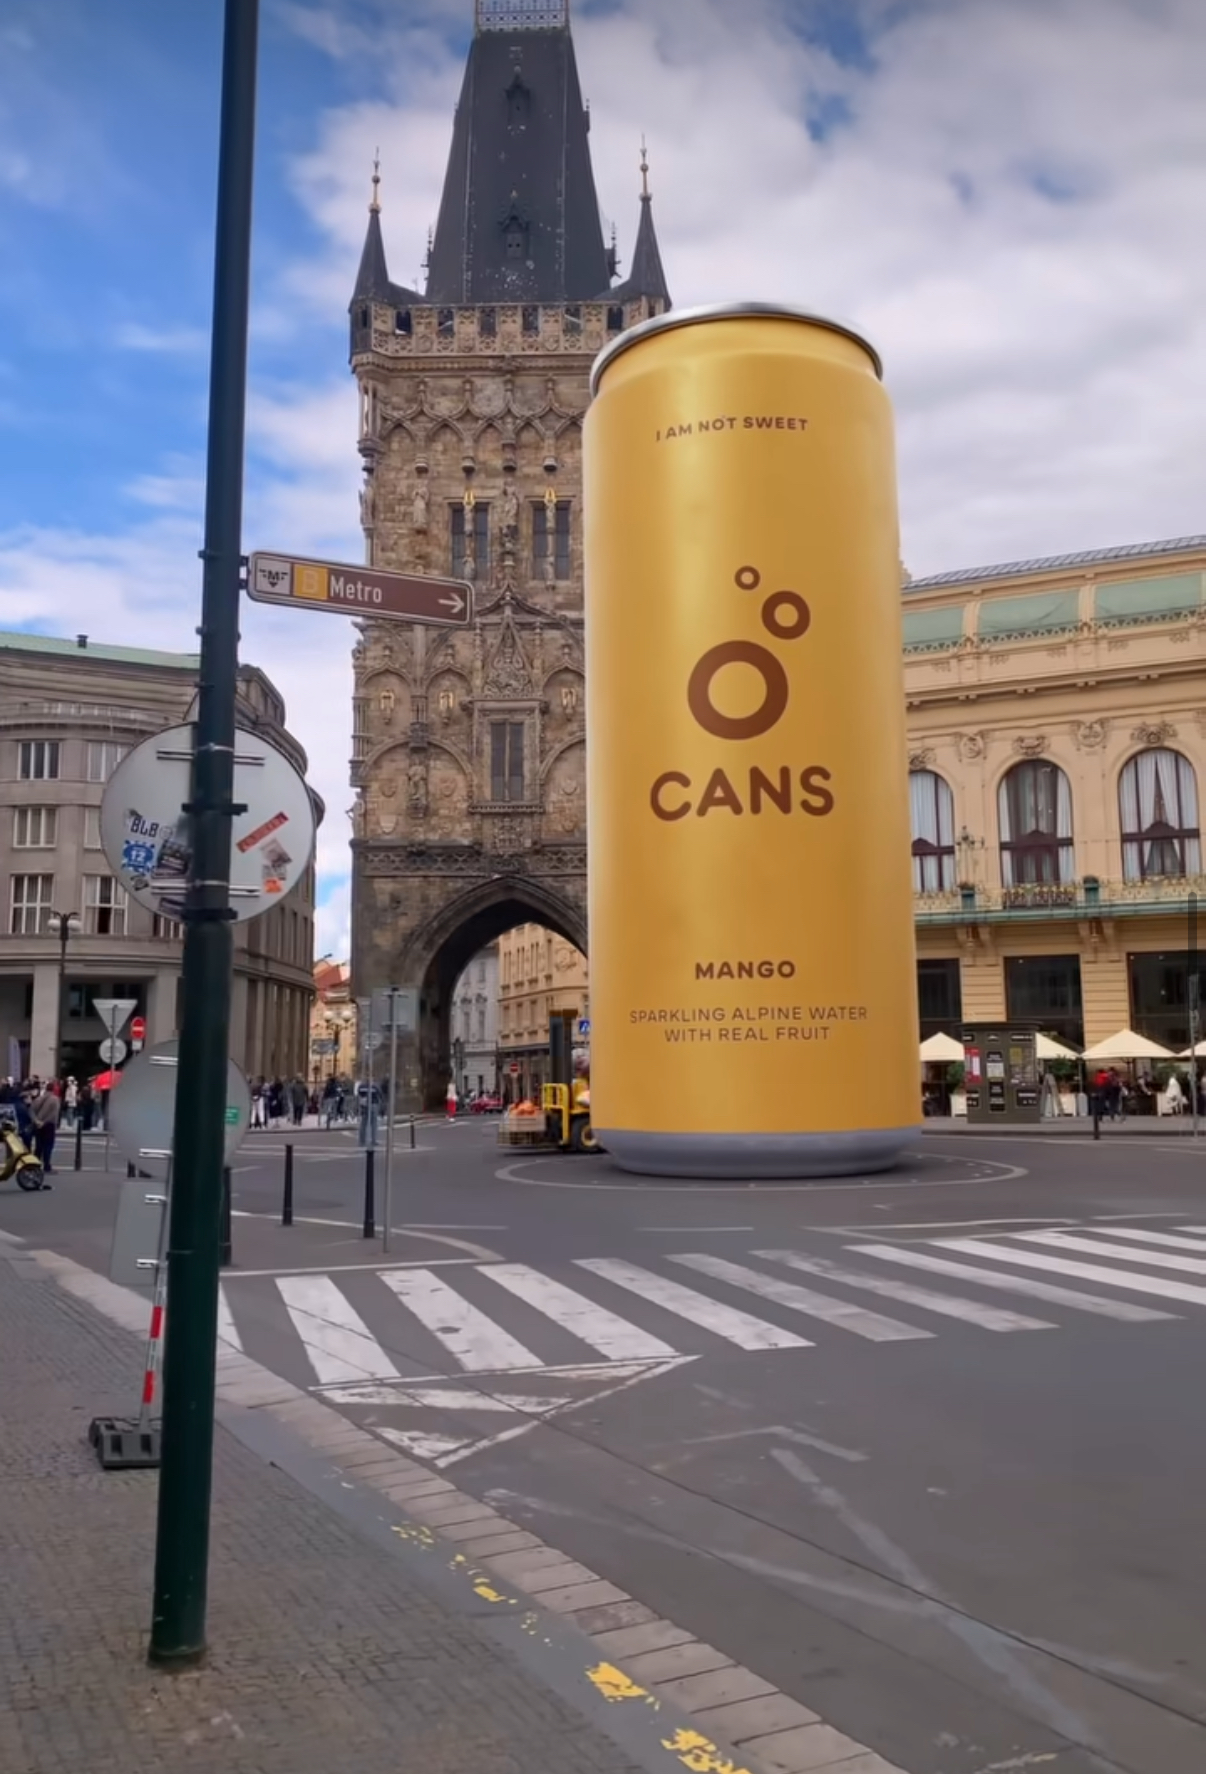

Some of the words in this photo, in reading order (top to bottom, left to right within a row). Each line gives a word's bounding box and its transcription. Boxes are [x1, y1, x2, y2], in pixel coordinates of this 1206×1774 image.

[656, 430, 661, 442] I
[665, 423, 693, 440] AM
[698, 417, 737, 432] NOT
[743, 416, 808, 431] SWEET
[302, 569, 319, 593] B
[330, 575, 383, 603] Metro
[650, 765, 834, 822] CANS
[694, 960, 796, 980] MANGO
[629, 1007, 726, 1024] SPARKLING
[731, 1006, 802, 1021] ALPINE
[808, 1005, 868, 1021] WATER
[664, 1028, 711, 1042] WITH
[718, 1026, 769, 1041] REAL
[776, 1025, 830, 1040] FRUIT
